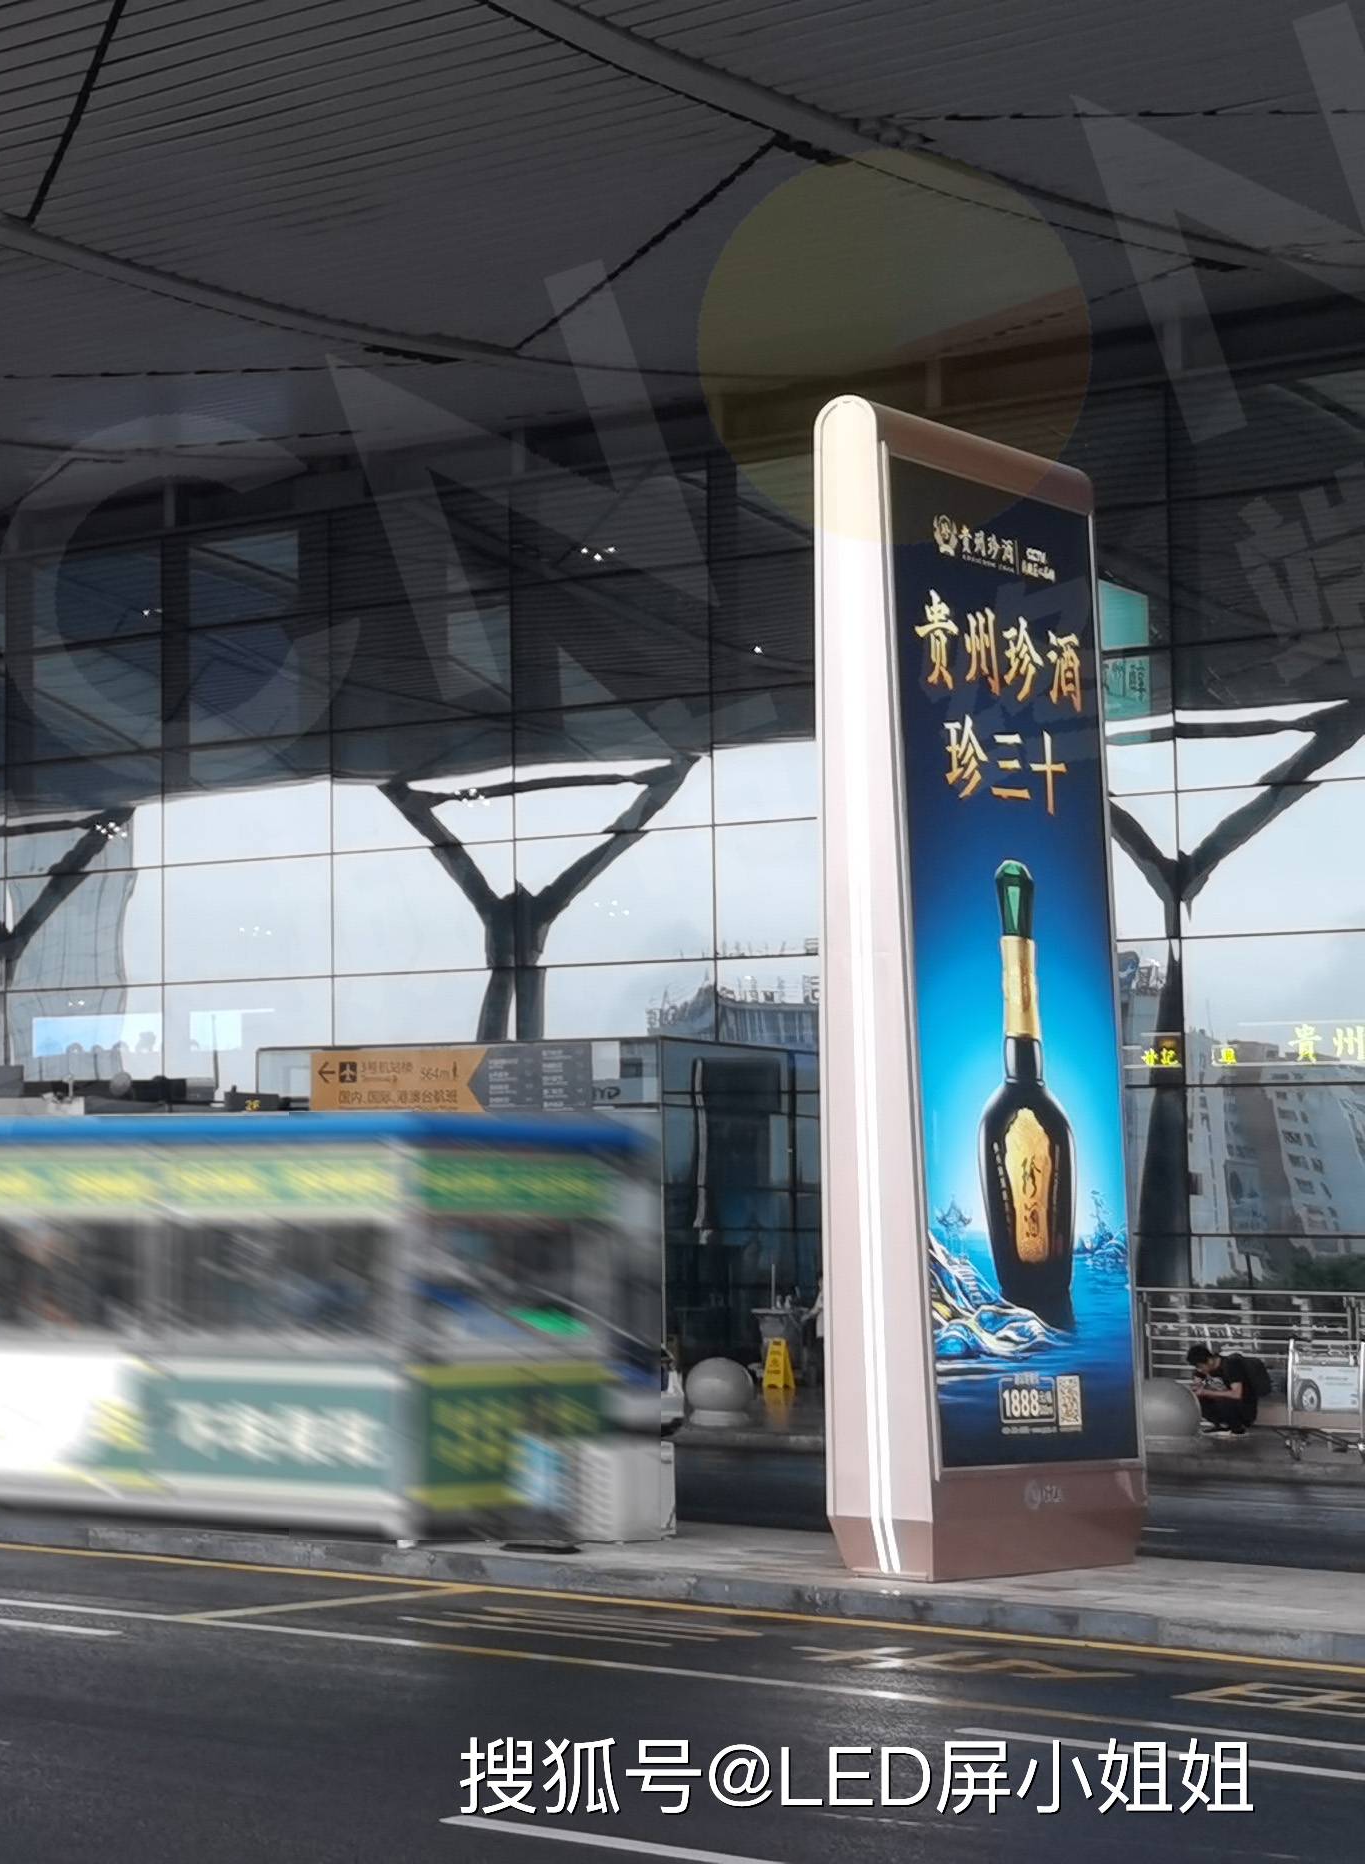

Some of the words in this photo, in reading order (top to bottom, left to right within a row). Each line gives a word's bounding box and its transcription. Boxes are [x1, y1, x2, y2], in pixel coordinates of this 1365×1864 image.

[914, 588, 1083, 713] 贵州珍酒
[943, 713, 1068, 817] 珍三十
[1002, 1388, 1039, 1417] 1888
